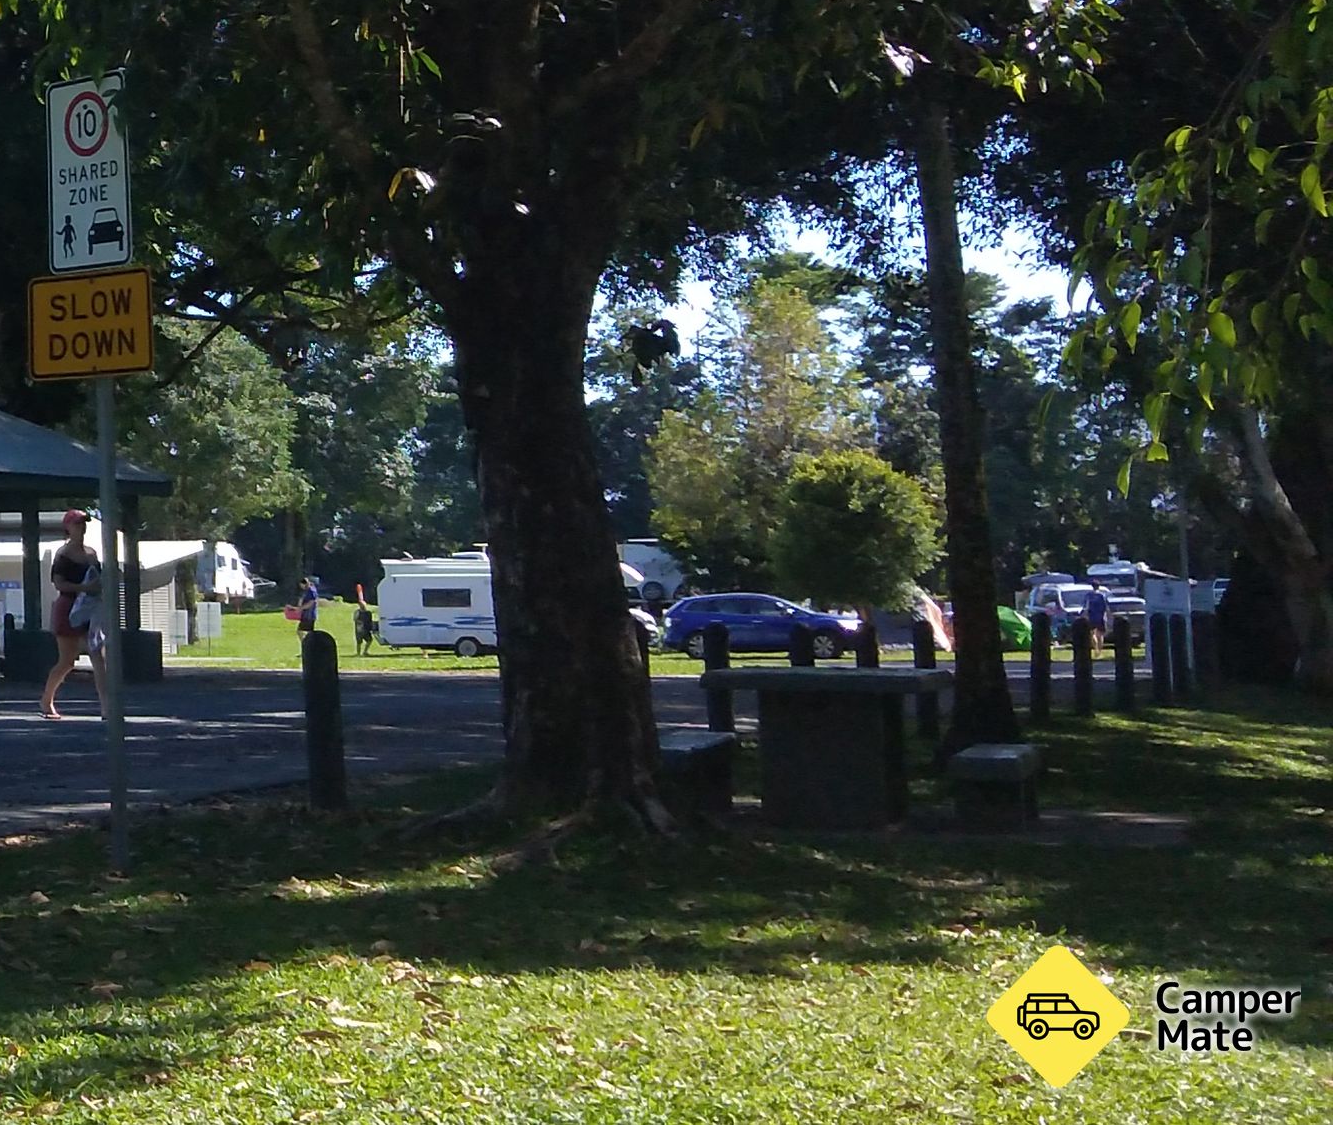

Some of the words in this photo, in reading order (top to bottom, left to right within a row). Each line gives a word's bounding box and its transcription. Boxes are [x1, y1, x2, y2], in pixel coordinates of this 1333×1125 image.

[76, 109, 96, 138] 10
[59, 160, 118, 185] SHARED
[69, 185, 108, 206] ZONE
[50, 288, 132, 321] SLOW
[49, 329, 135, 361] DOWN
